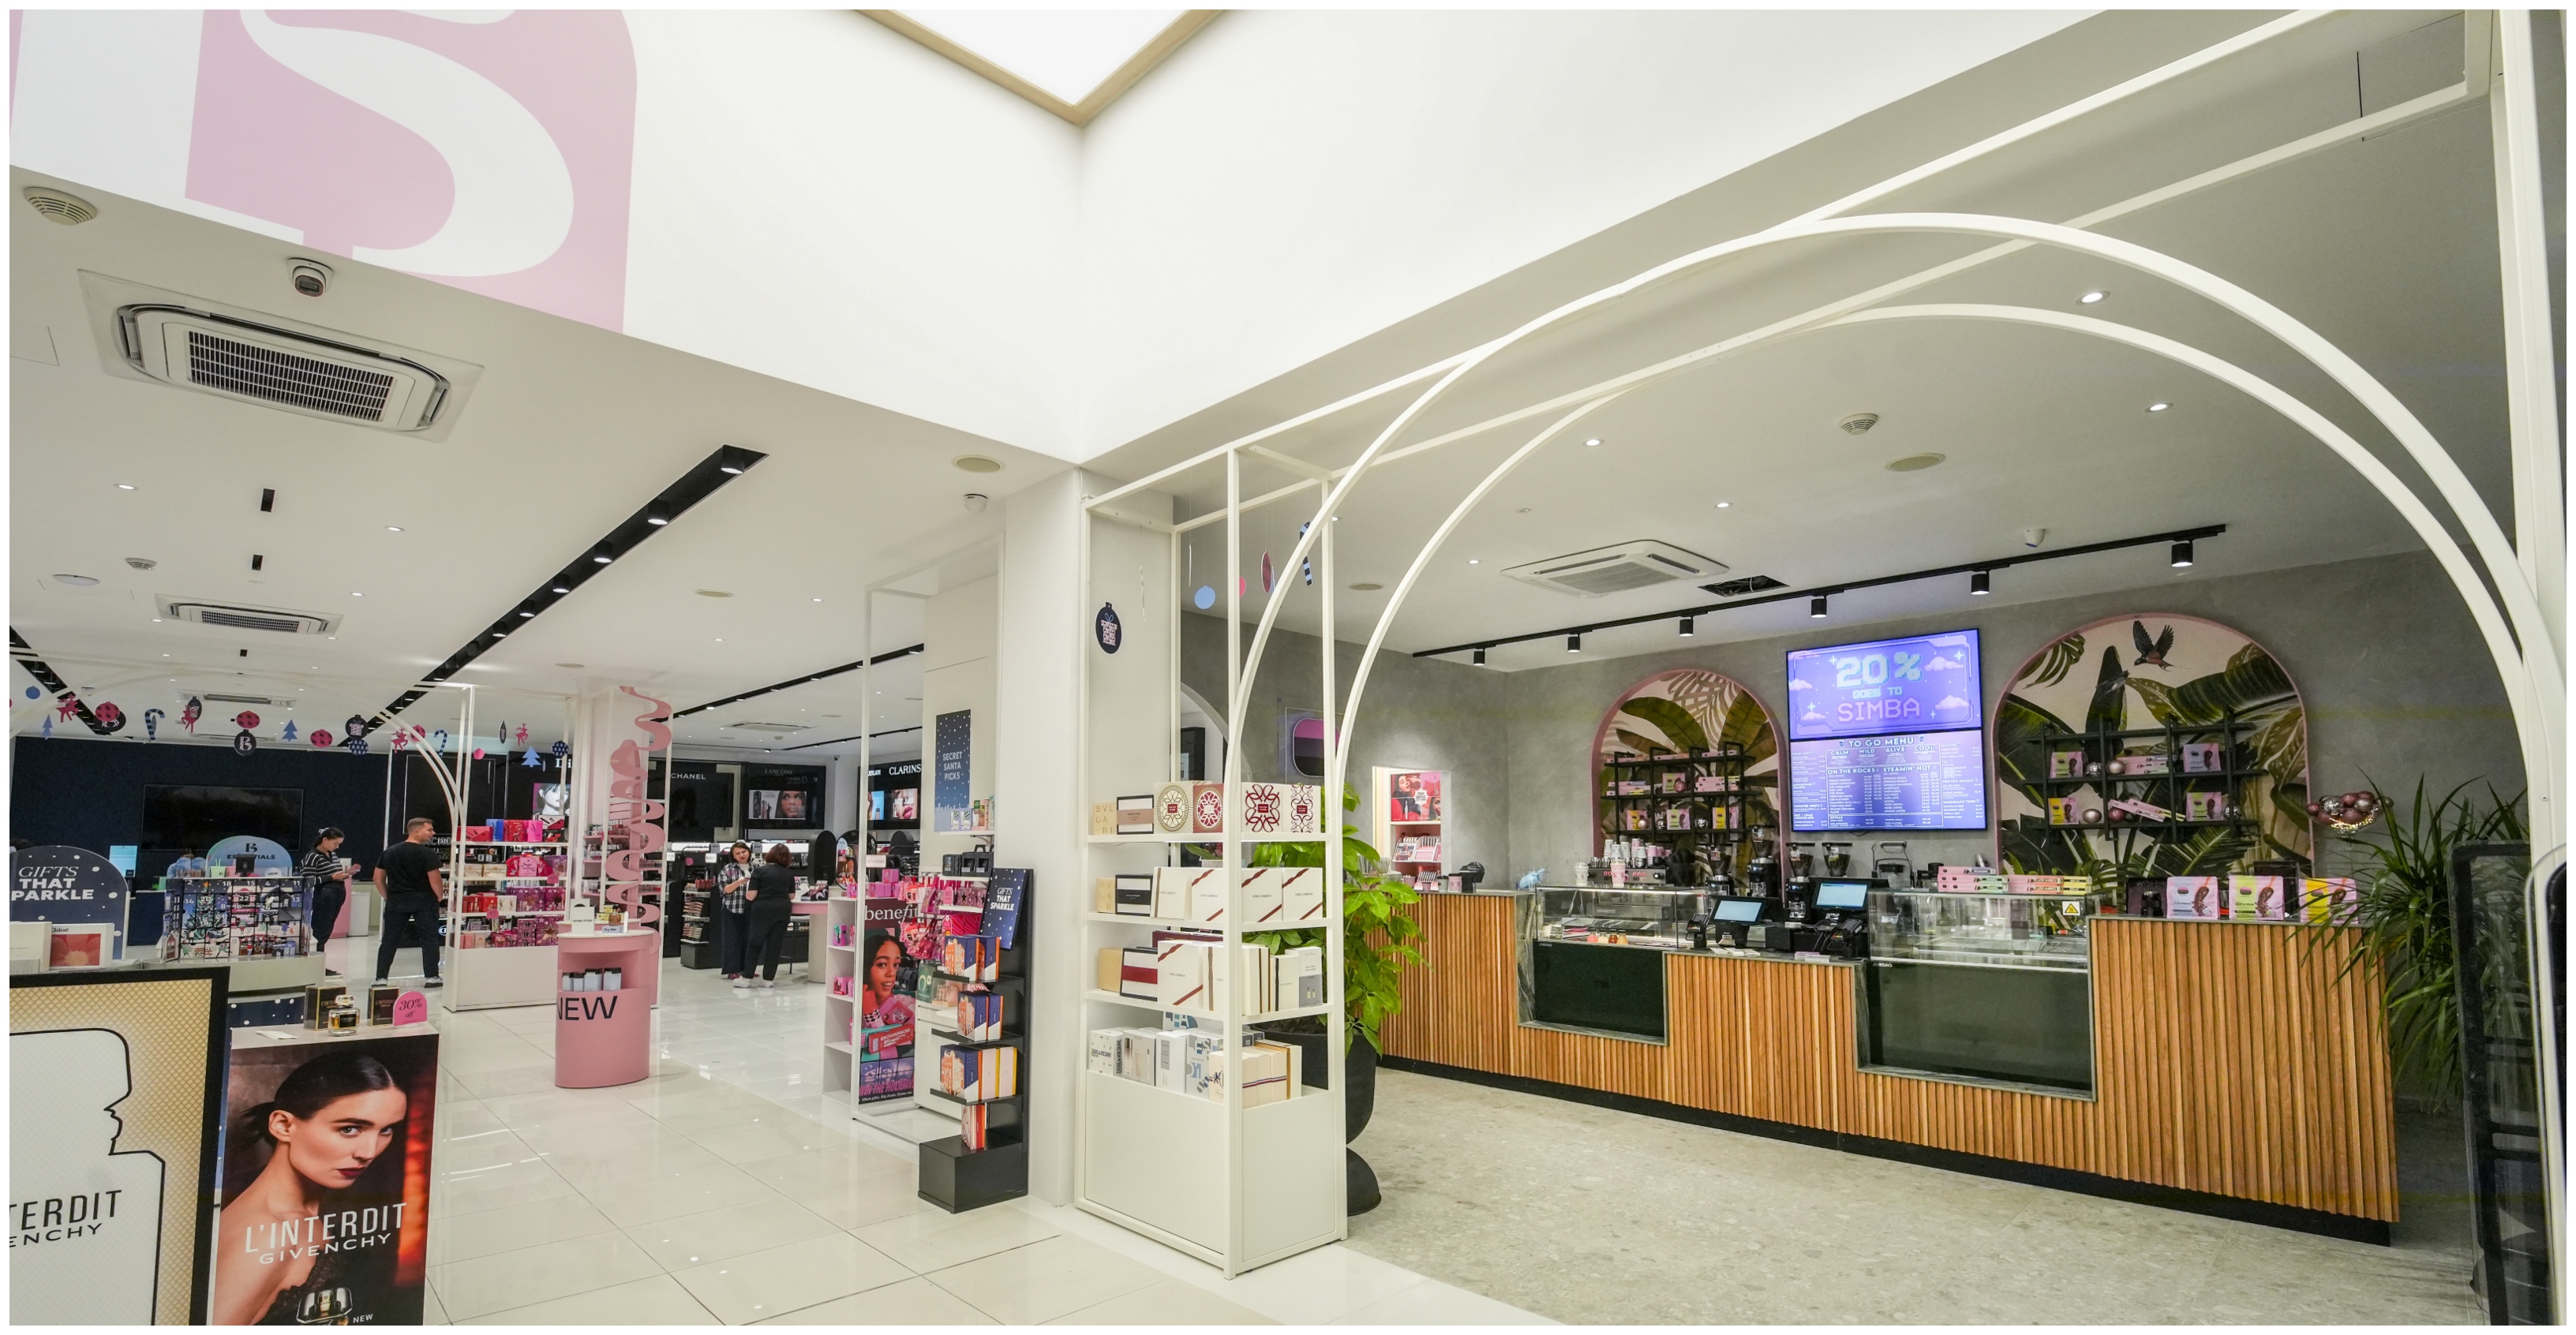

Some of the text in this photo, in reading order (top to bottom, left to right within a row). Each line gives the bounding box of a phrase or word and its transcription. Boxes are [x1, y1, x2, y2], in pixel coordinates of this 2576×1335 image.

[1852, 686, 1903, 699] GOES TO
[1837, 697, 1920, 723] SIMBA
[1885, 737, 1914, 746] MENU
[942, 751, 963, 761] SECRET
[889, 764, 922, 776] CLARINS
[943, 762, 961, 771] SANTA
[18, 866, 79, 877] GIFTS
[19, 878, 76, 889] THAT
[11, 889, 95, 901] PARKLE
[990, 902, 1015, 911] SPARKLE
[864, 903, 919, 924] benefit
[399, 997, 423, 1011] 30%
[245, 1202, 407, 1253] L'INTERDIT
[259, 1232, 391, 1265] GIVENCHY
[353, 1314, 373, 1324] NEW
